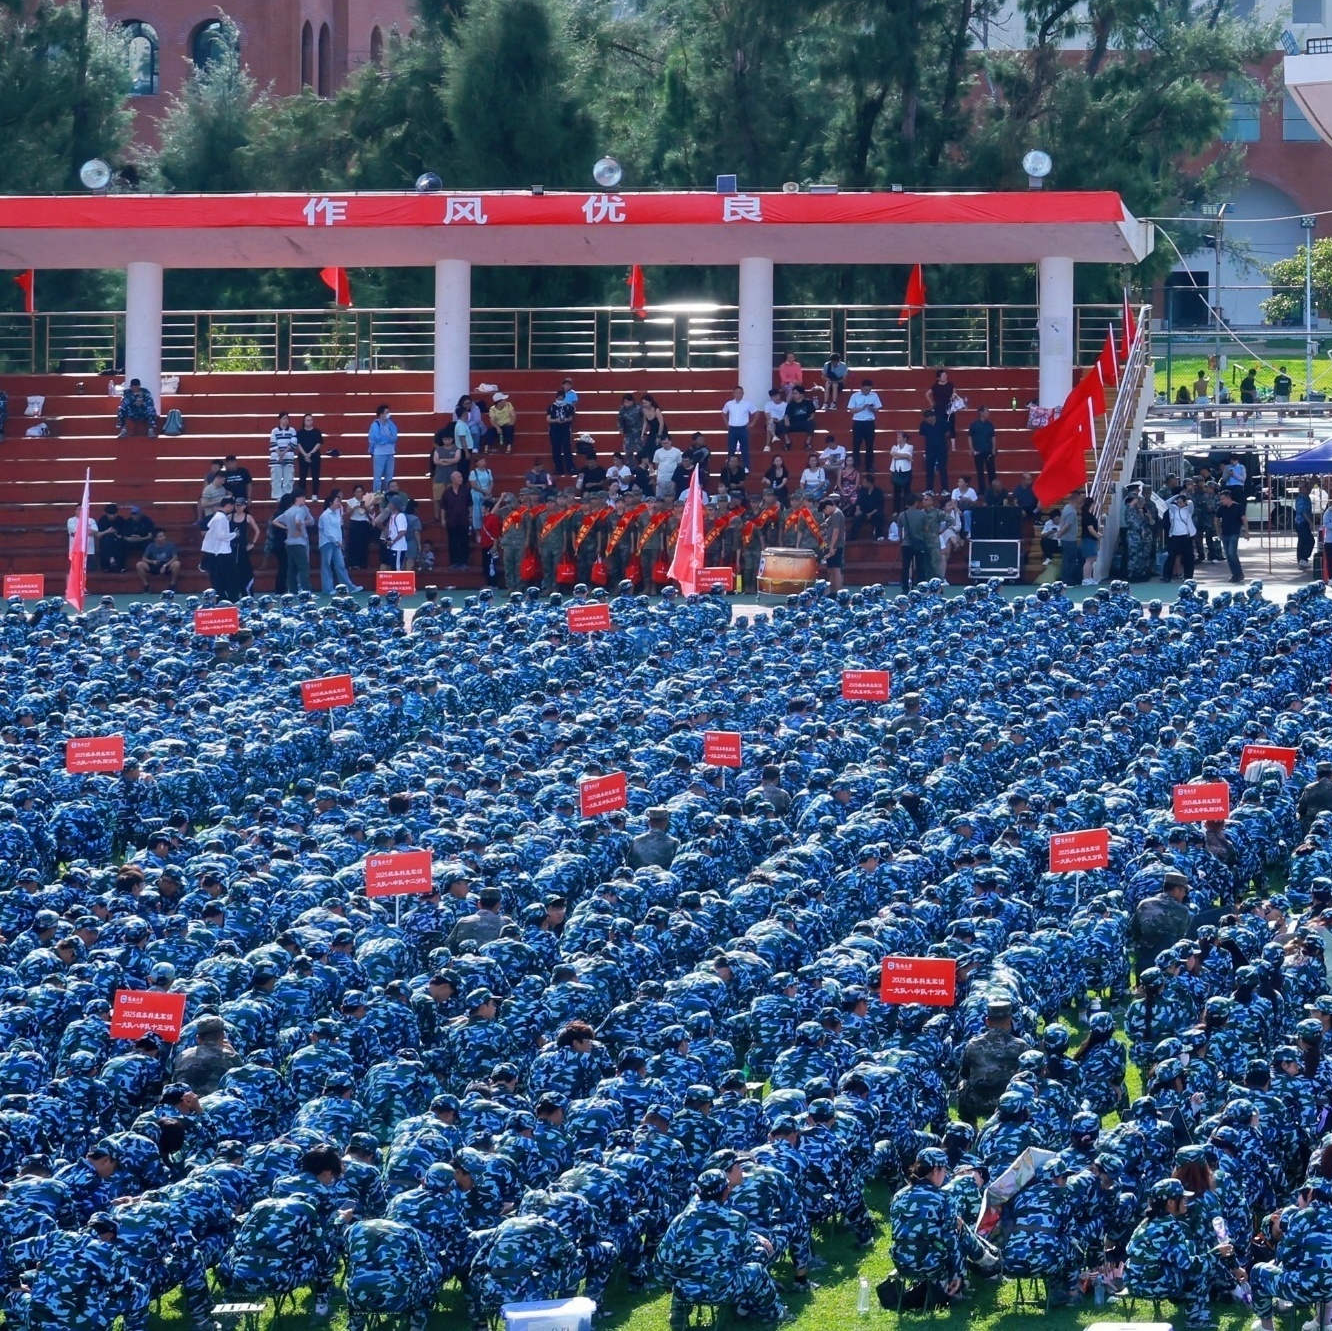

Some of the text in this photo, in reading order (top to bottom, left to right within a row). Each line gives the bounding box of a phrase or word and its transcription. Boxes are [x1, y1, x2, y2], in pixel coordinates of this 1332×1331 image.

[303, 195, 763, 226] 作风优良
[1058, 845, 1100, 856] 2025级本科生军训
[375, 869, 422, 878] 2025级本科生军训
[892, 977, 944, 985] 2025级本科生军训
[886, 987, 948, 996] 一大队八中队十分队
[122, 1011, 173, 1020] 2025级本科生军训
[116, 1023, 175, 1032] 一大队八中队十三分队
